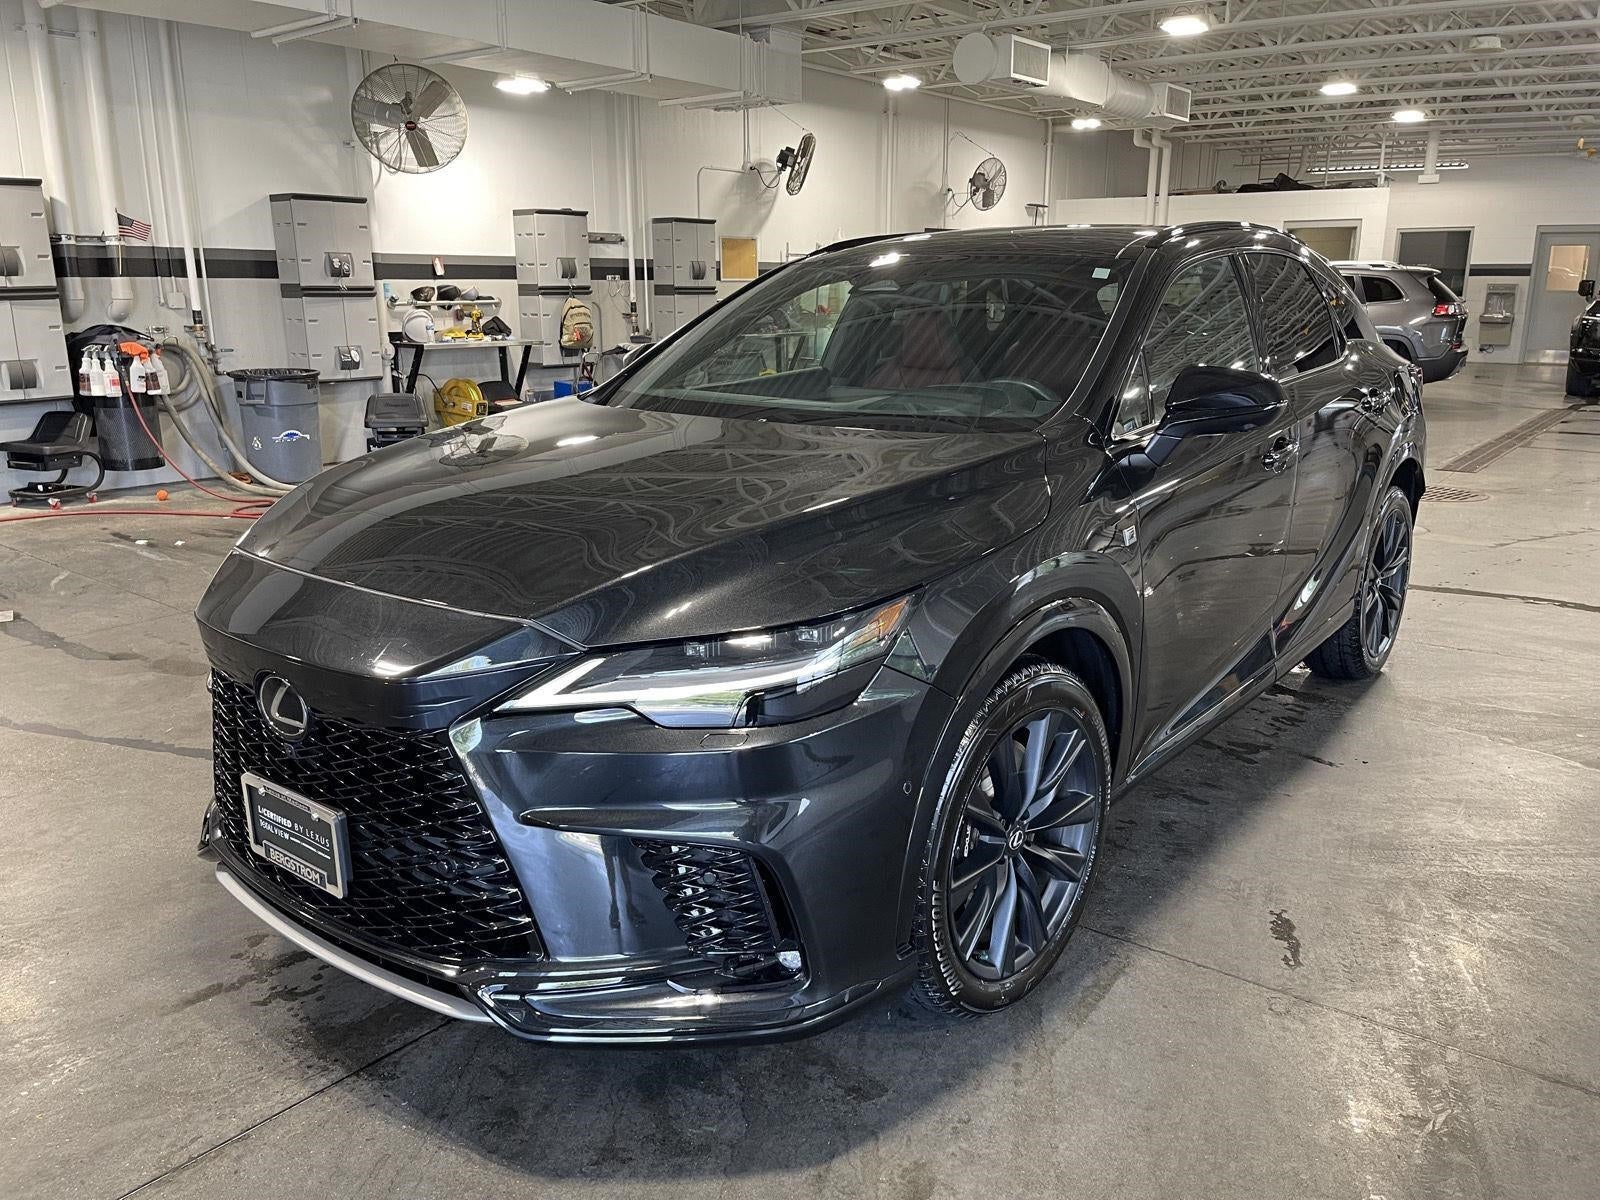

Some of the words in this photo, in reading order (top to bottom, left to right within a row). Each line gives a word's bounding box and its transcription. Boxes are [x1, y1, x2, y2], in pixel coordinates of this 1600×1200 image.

[294, 822, 304, 834] BY
[305, 828, 330, 848] LEXUS
[270, 847, 320, 885] BERGSTROM
[931, 880, 964, 996] BRIDGESTONE
